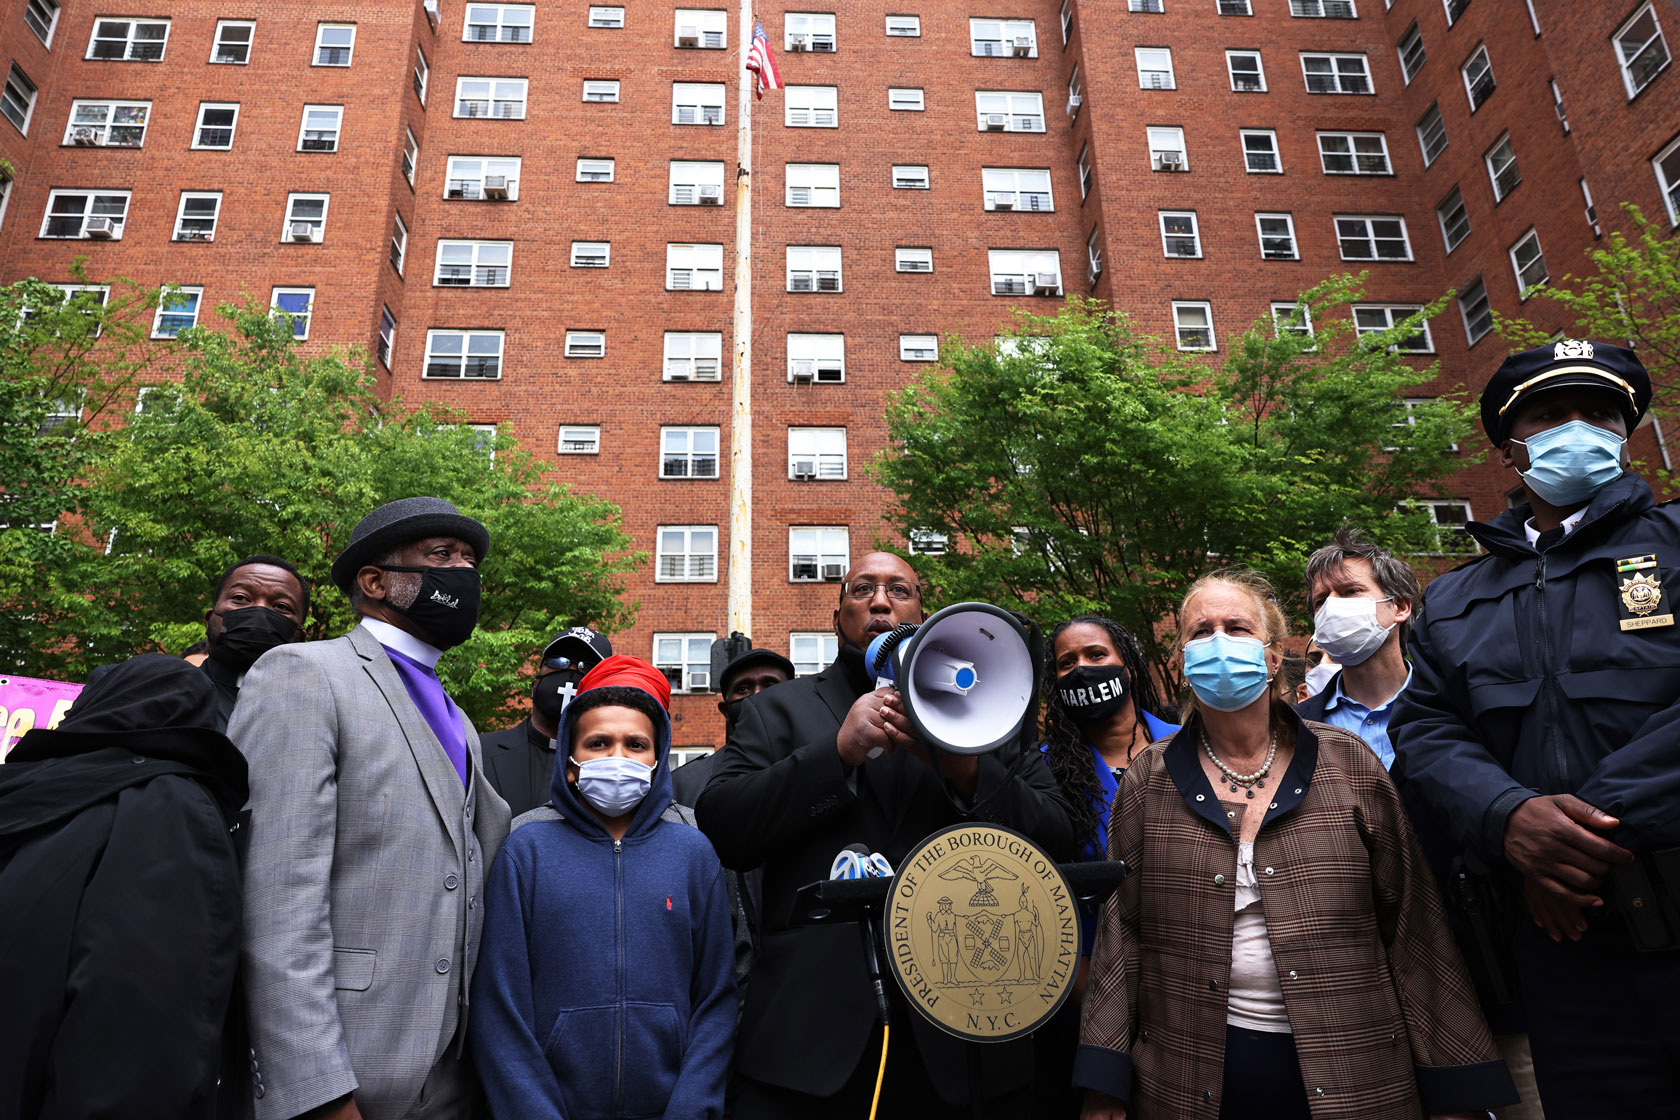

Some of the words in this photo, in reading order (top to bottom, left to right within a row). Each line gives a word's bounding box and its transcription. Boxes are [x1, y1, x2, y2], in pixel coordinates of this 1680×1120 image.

[1626, 617, 1667, 628] SHEPPARD
[1060, 677, 1123, 707] HARLEM
[913, 842, 946, 873] THE
[947, 832, 1033, 863] BOROUGH
[1034, 860, 1055, 882] OF
[900, 875, 917, 898] OF
[894, 902, 940, 1009] PRESIDENT
[1039, 885, 1074, 1005] MANHATTAN
